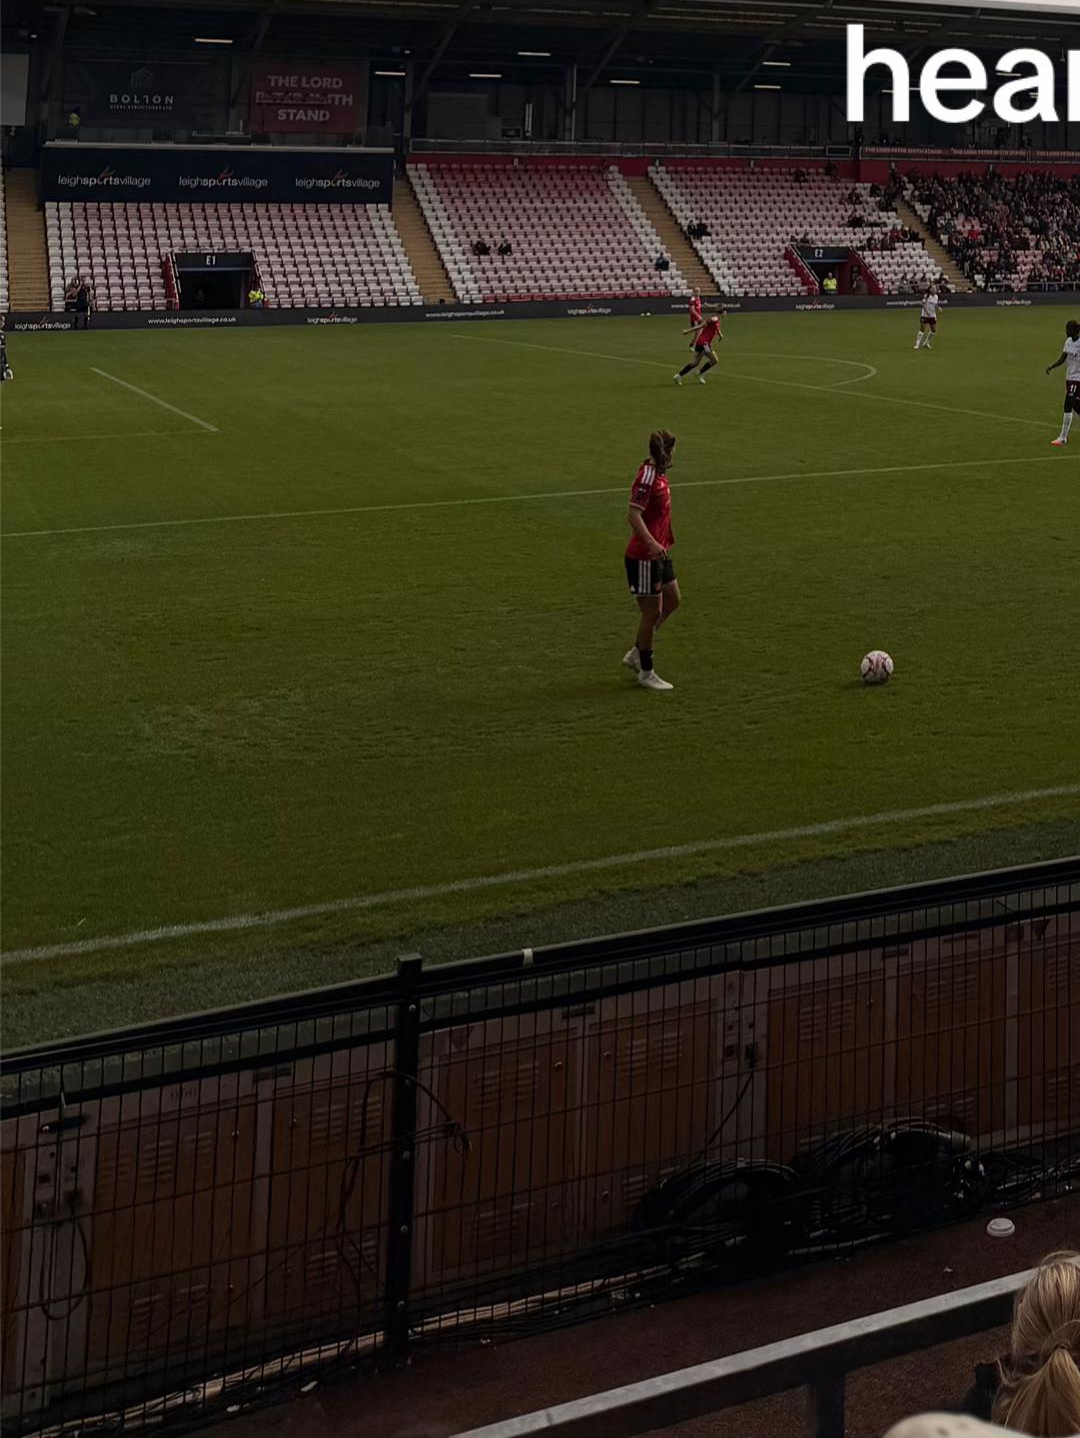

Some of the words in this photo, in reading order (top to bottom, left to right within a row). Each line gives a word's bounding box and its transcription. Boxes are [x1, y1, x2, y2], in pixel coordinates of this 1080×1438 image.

[267, 75, 299, 88] THE
[302, 76, 343, 89] LORD
[109, 94, 174, 105] BOLTON
[277, 109, 330, 122] STAND
[206, 255, 216, 266] E1
